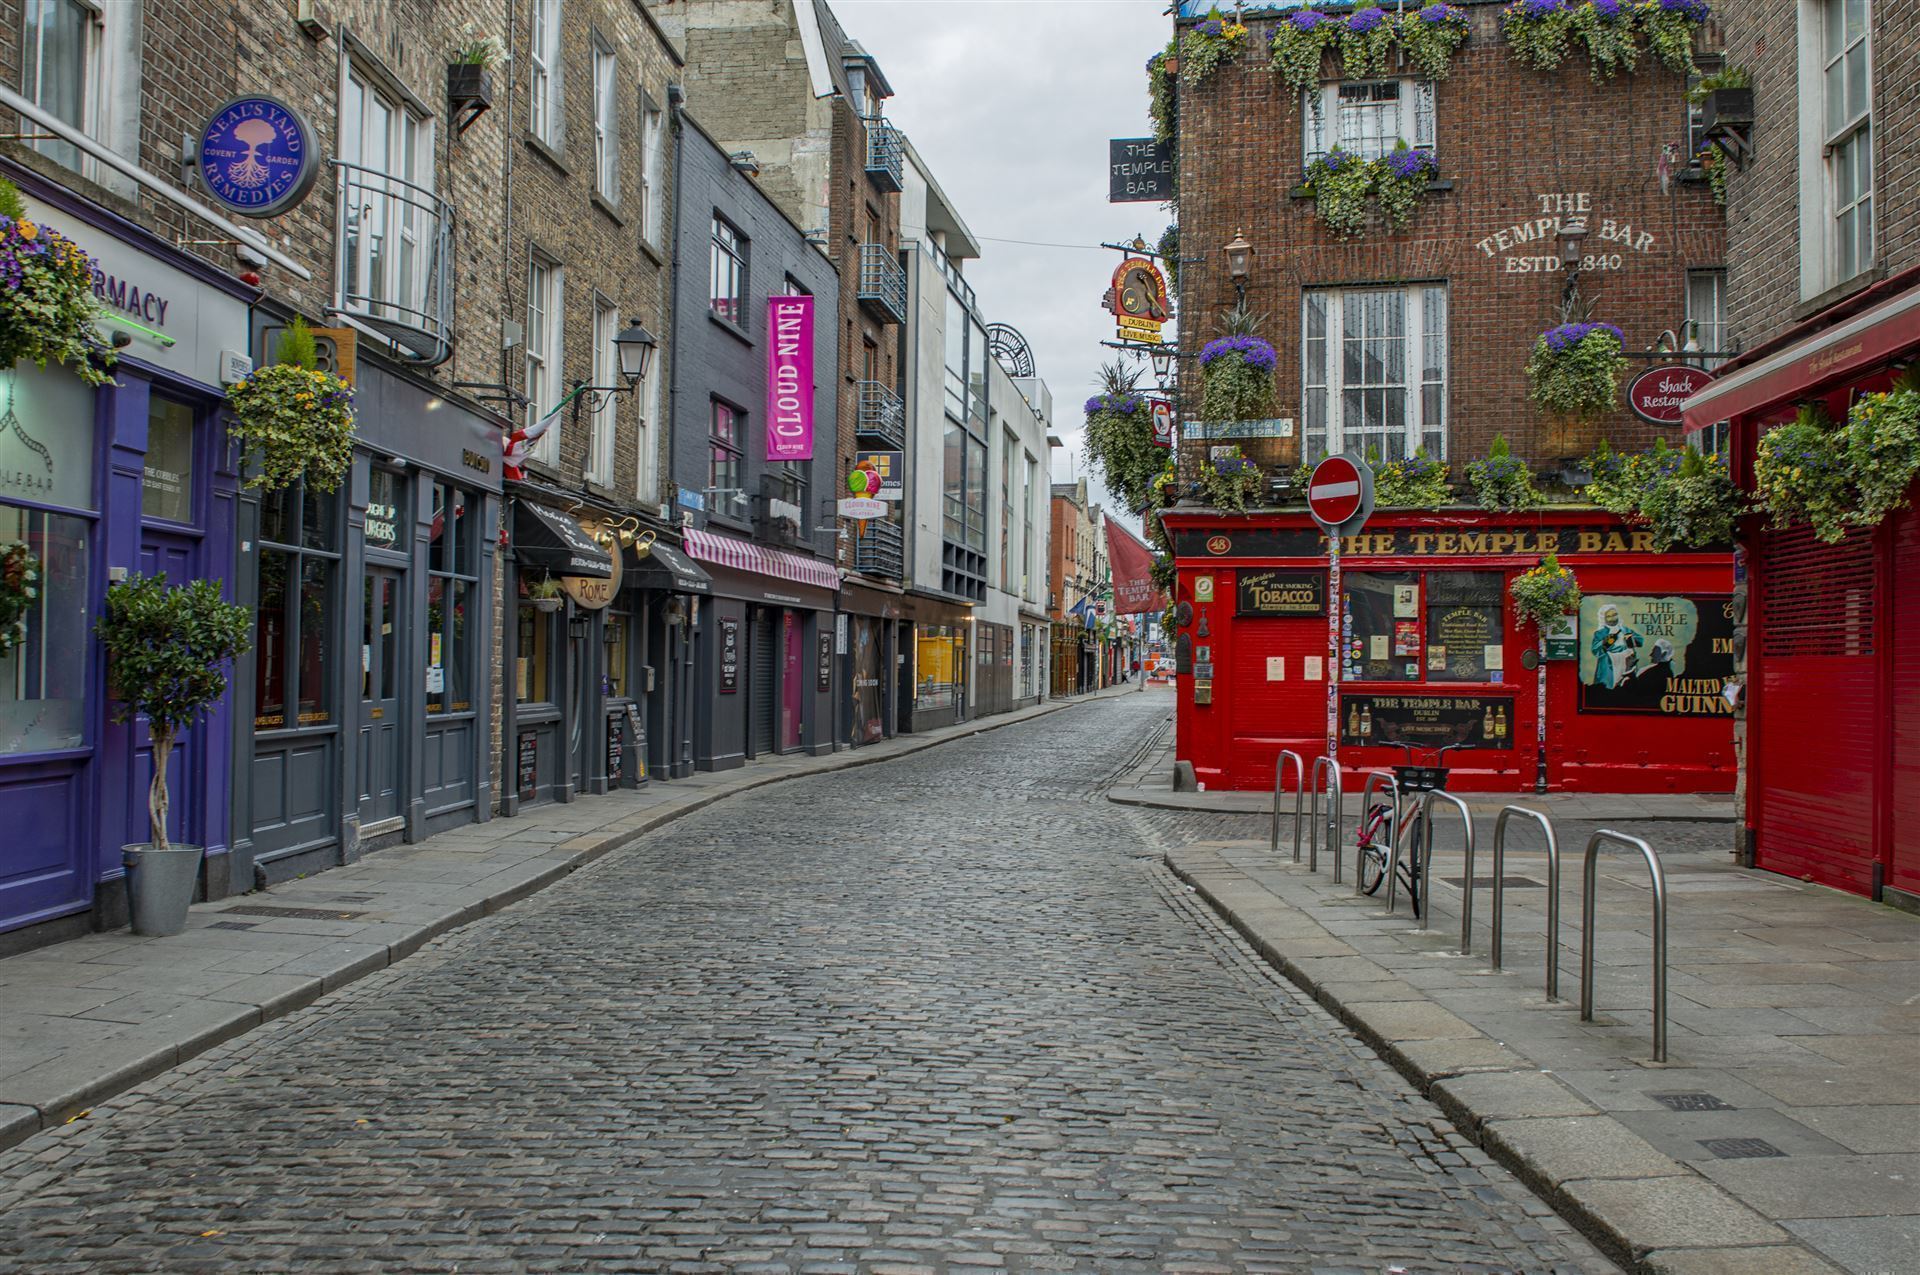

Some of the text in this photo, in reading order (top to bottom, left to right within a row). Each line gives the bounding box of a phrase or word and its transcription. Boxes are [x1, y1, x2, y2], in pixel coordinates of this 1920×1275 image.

[207, 103, 300, 152] NEAL'S YARD
[204, 148, 237, 158] COVENT
[1126, 144, 1156, 157] THE
[265, 155, 299, 166] GARDEN
[1112, 160, 1171, 176] TEMPLE
[206, 162, 293, 203] REMEDIES
[1126, 180, 1157, 194] BAR
[1538, 192, 1592, 213] THE
[1599, 218, 1655, 254] BAR
[1578, 254, 1622, 272] 840
[777, 303, 805, 356] NINE
[1128, 318, 1154, 329] DUBLIN
[1123, 330, 1159, 341] LIVE MUSIC
[1658, 375, 1694, 395] Shack
[777, 365, 804, 437] CLOUD
[1283, 423, 1290, 433] 2
[1211, 538, 1226, 550] 48
[1410, 533, 1559, 554] TEMPLE
[1578, 532, 1654, 552] BAR
[579, 579, 609, 601] ROME
[1248, 586, 1314, 608] TOBACCO
[1128, 594, 1149, 602] BAR
[1645, 602, 1675, 614] THE
[1442, 609, 1488, 623] TEMPLE BAR
[1631, 613, 1688, 625] TEMPLE
[1646, 625, 1675, 637] BAR
[1665, 677, 1721, 695] MALTED
[1372, 698, 1482, 710] THE TEMPLE BAR
